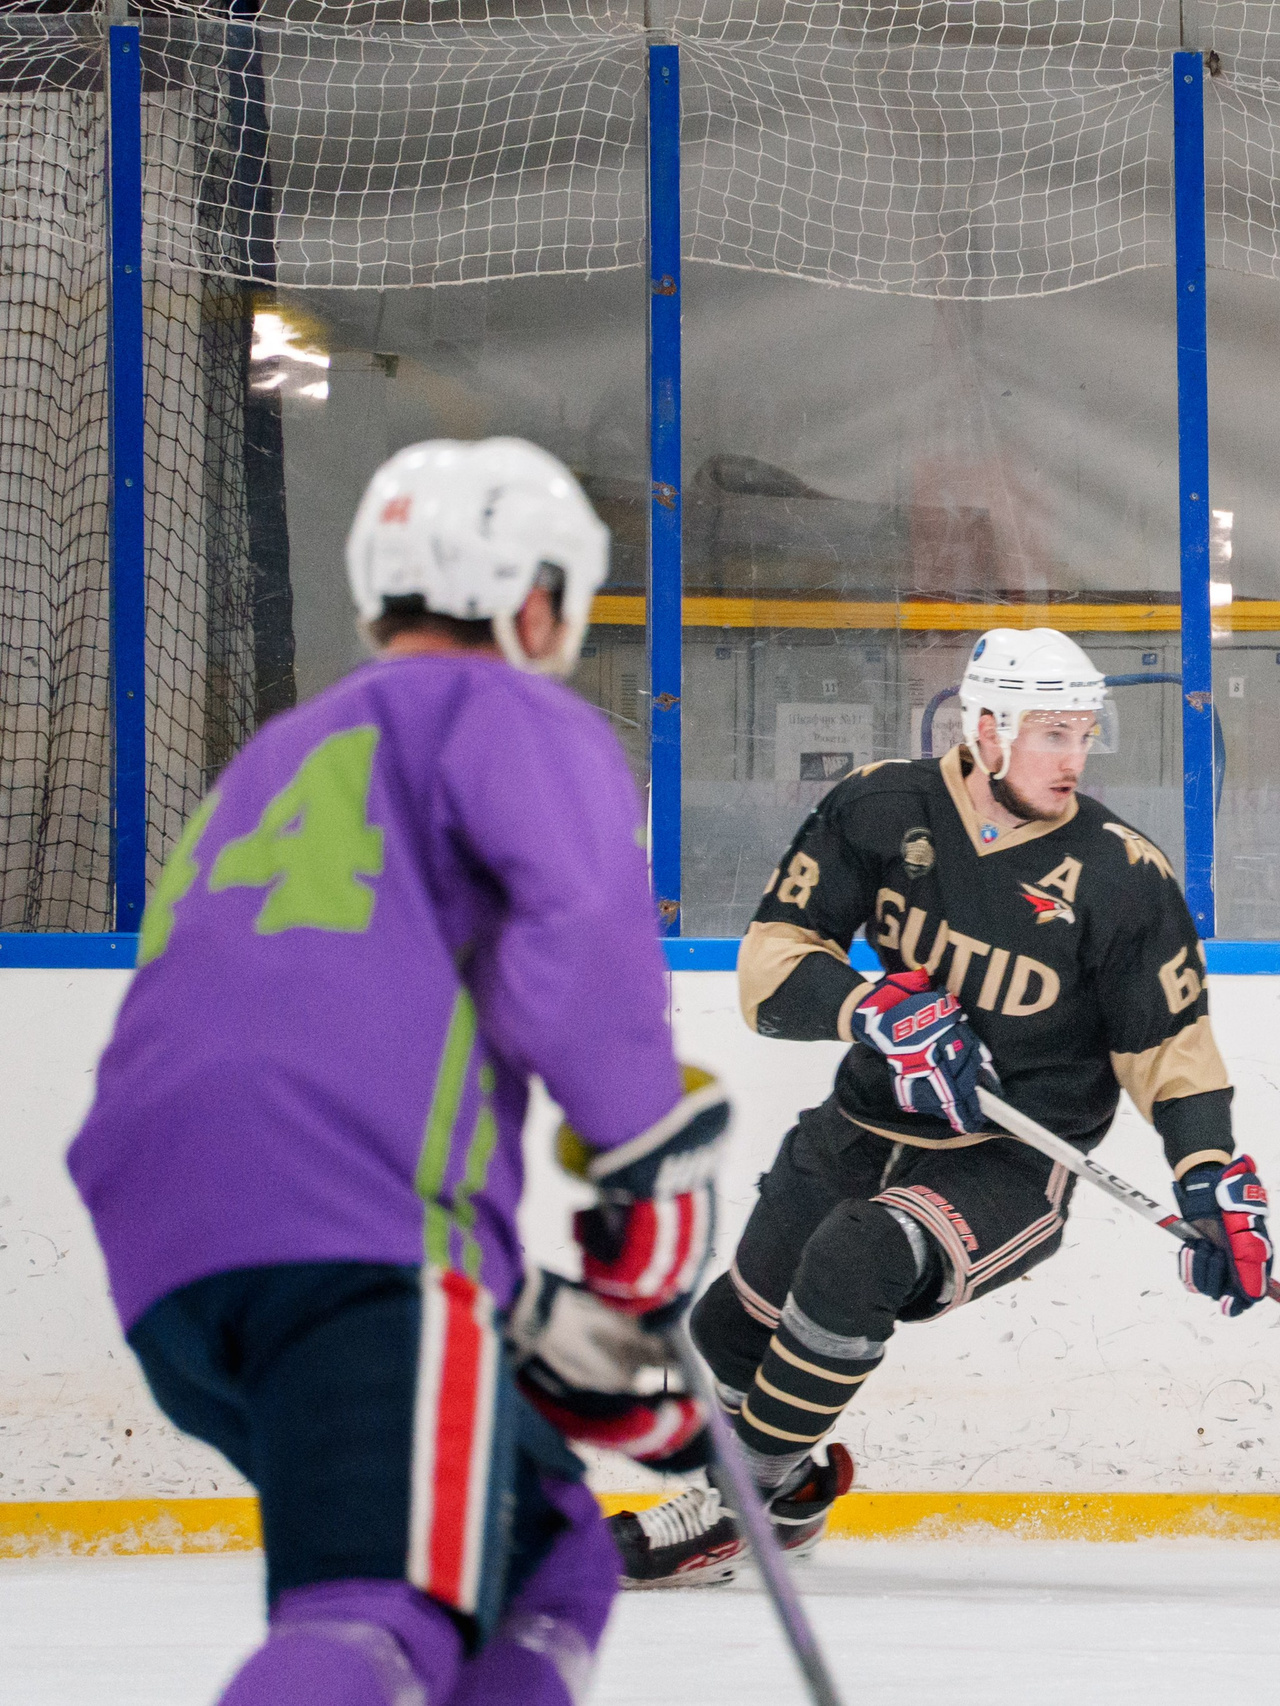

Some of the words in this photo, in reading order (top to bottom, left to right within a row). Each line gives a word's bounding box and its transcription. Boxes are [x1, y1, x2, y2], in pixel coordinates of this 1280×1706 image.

[763, 851, 820, 910] 8
[1038, 855, 1084, 903] A
[875, 887, 1061, 1017] GUTID
[1157, 938, 1207, 1015] 6
[892, 992, 962, 1043] BAU
[1083, 1158, 1160, 1210] CCM
